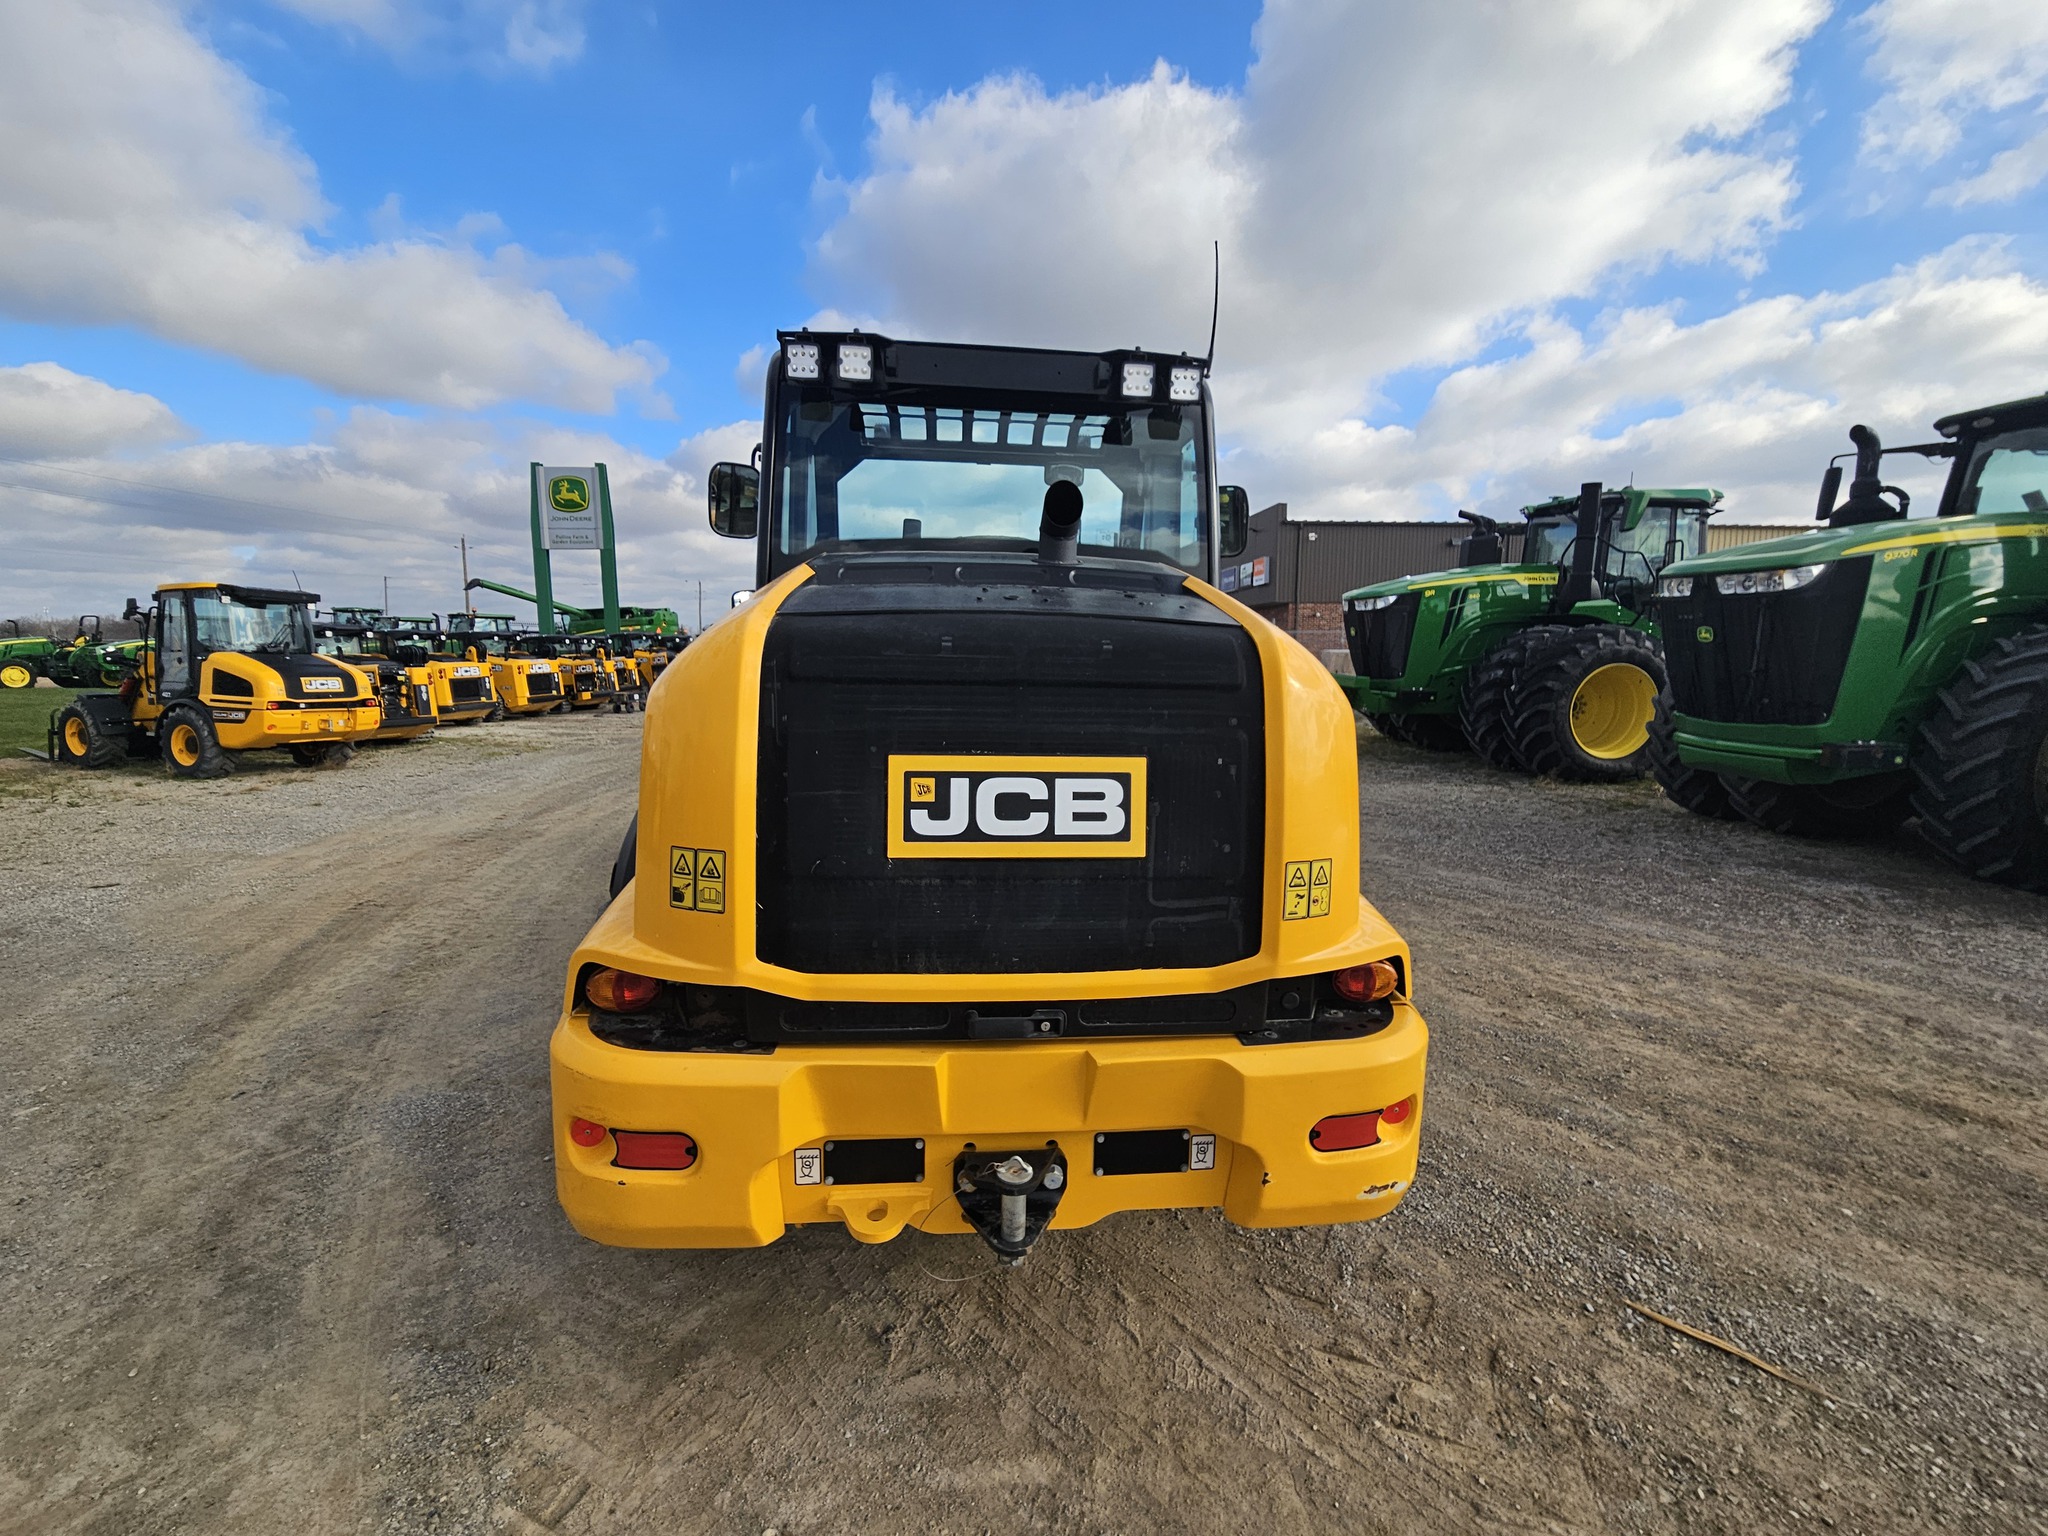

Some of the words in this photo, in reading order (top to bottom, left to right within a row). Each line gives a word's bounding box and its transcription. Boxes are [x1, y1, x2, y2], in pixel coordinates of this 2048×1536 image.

[453, 666, 480, 677] JCB
[529, 663, 551, 674] JCB
[575, 664, 593, 673] JCB
[305, 679, 341, 690] JCB
[910, 777, 1126, 836] JCB
